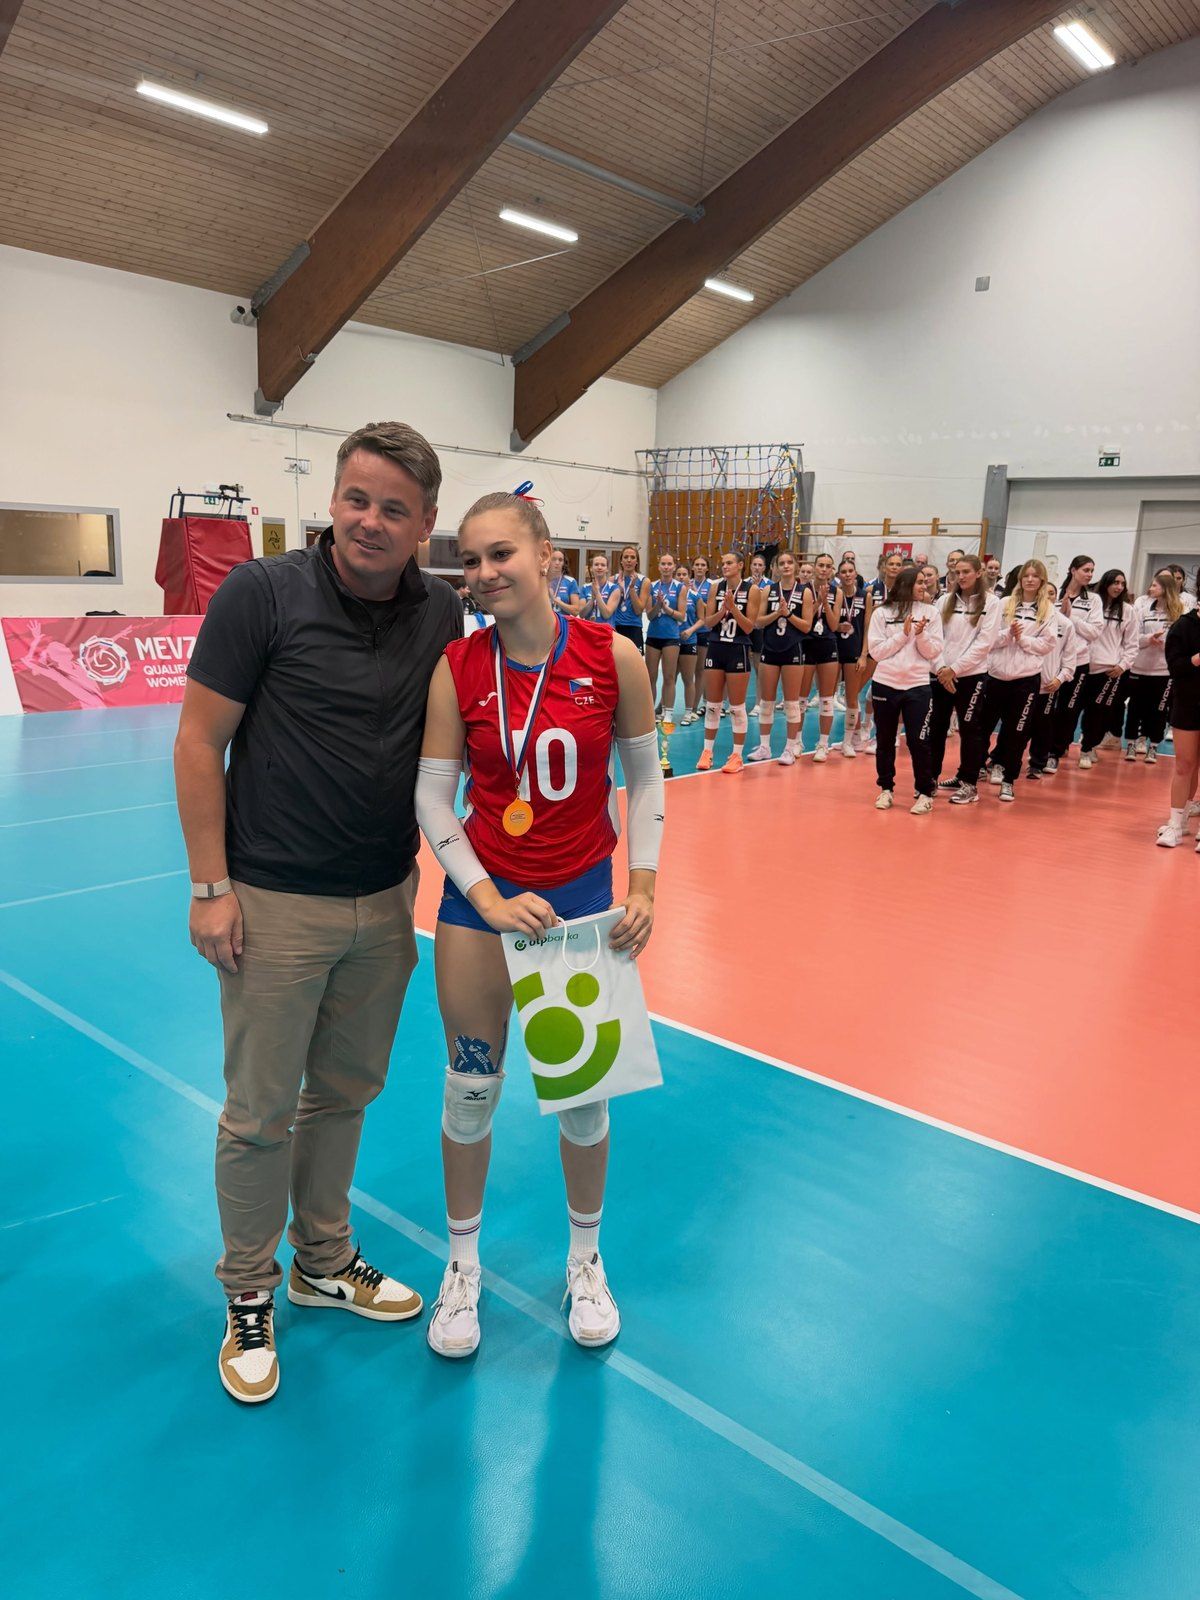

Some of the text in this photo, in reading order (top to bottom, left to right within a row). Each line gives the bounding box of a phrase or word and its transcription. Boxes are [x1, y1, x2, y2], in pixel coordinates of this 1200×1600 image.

[574, 696, 595, 705] CZE
[964, 681, 984, 722] GIVOVA
[1068, 673, 1085, 708] GIVOVA
[1016, 692, 1035, 731] GIVOVA
[511, 727, 578, 802] 10
